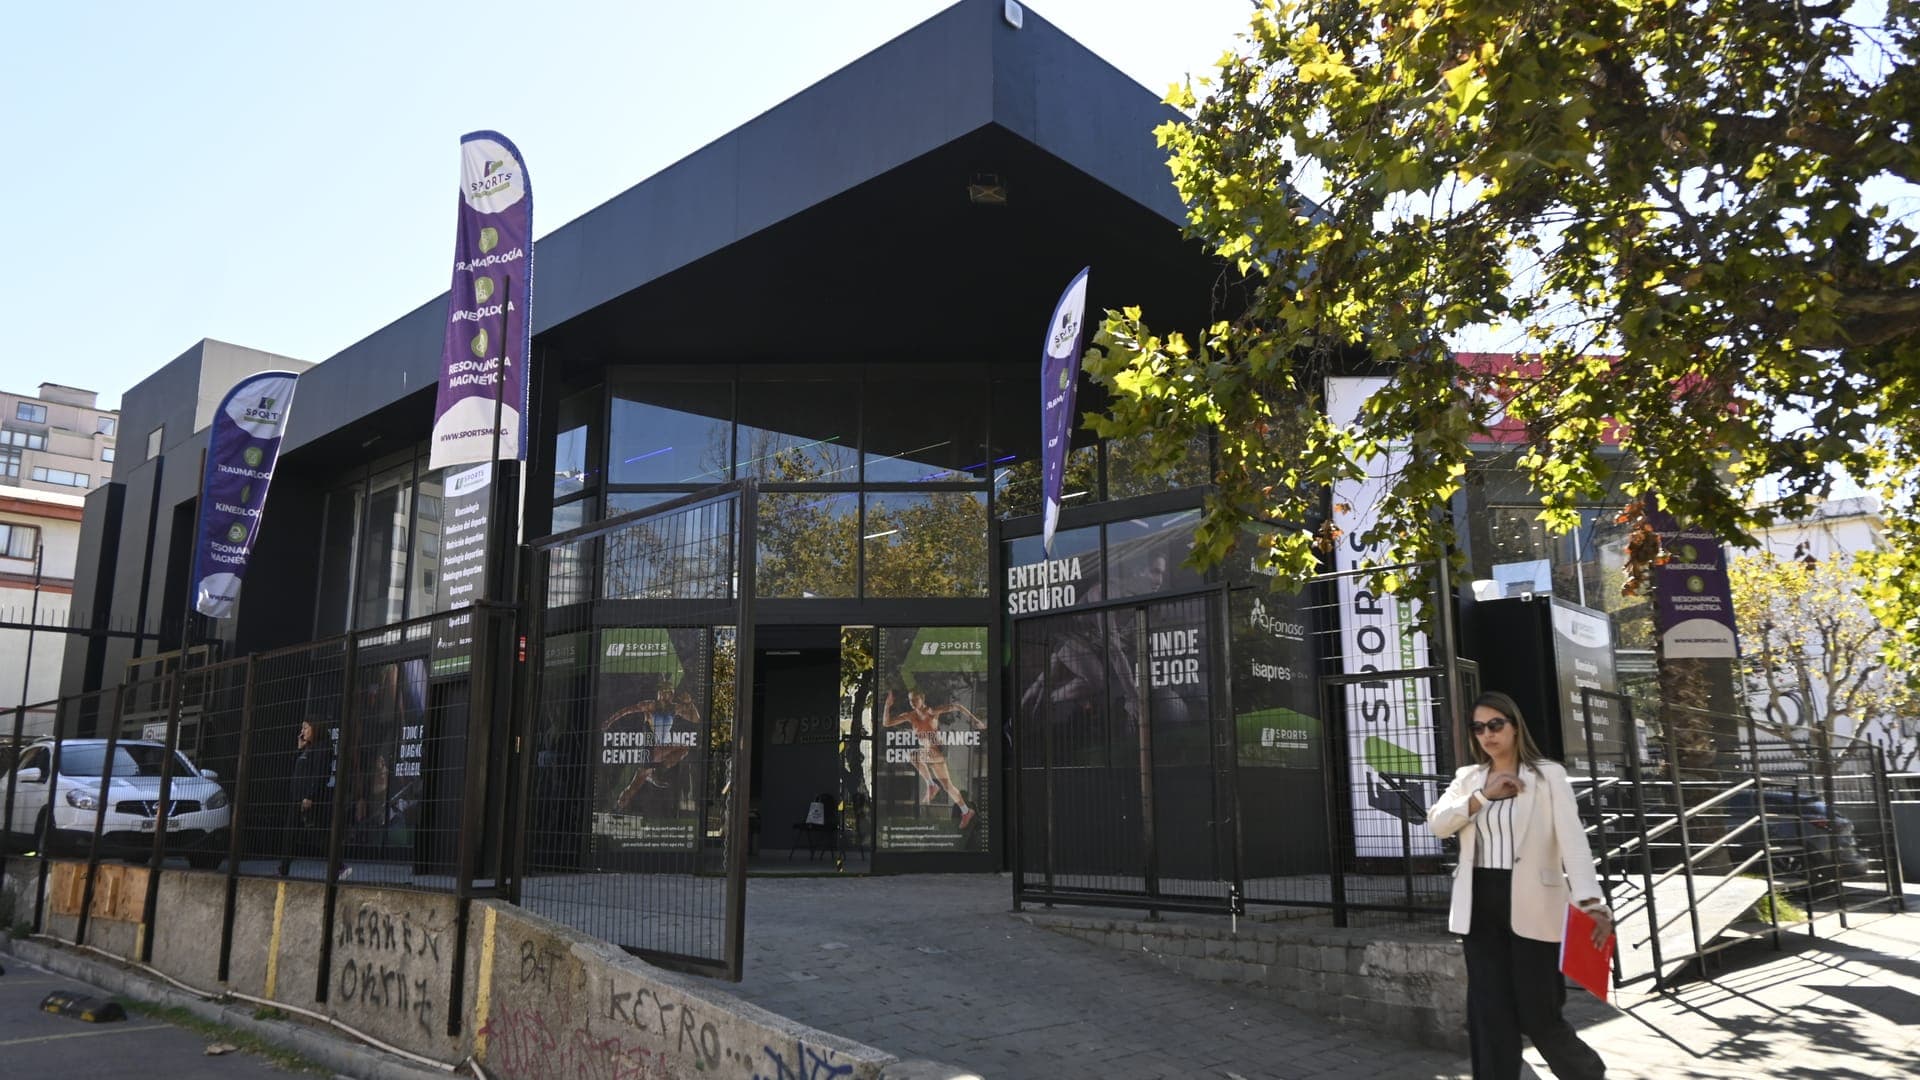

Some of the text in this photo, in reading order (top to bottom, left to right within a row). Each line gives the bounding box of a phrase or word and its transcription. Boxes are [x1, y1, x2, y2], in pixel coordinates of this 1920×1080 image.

[471, 172, 513, 192] SPORTS
[448, 355, 512, 376] RESONANCA
[449, 371, 506, 389] MAGNÉTIC
[1008, 557, 1082, 590] ENTRENA
[1008, 585, 1076, 615] SEGURO
[1349, 530, 1392, 723] SPORS
[626, 643, 668, 651] SPORTS
[940, 641, 982, 650] SPORTS
[1148, 629, 1199, 657] INDE
[1135, 659, 1200, 688] EJOR
[1251, 657, 1292, 682] isapres
[885, 731, 981, 747] PERFORMANCE
[1275, 728, 1308, 741] SPORTS
